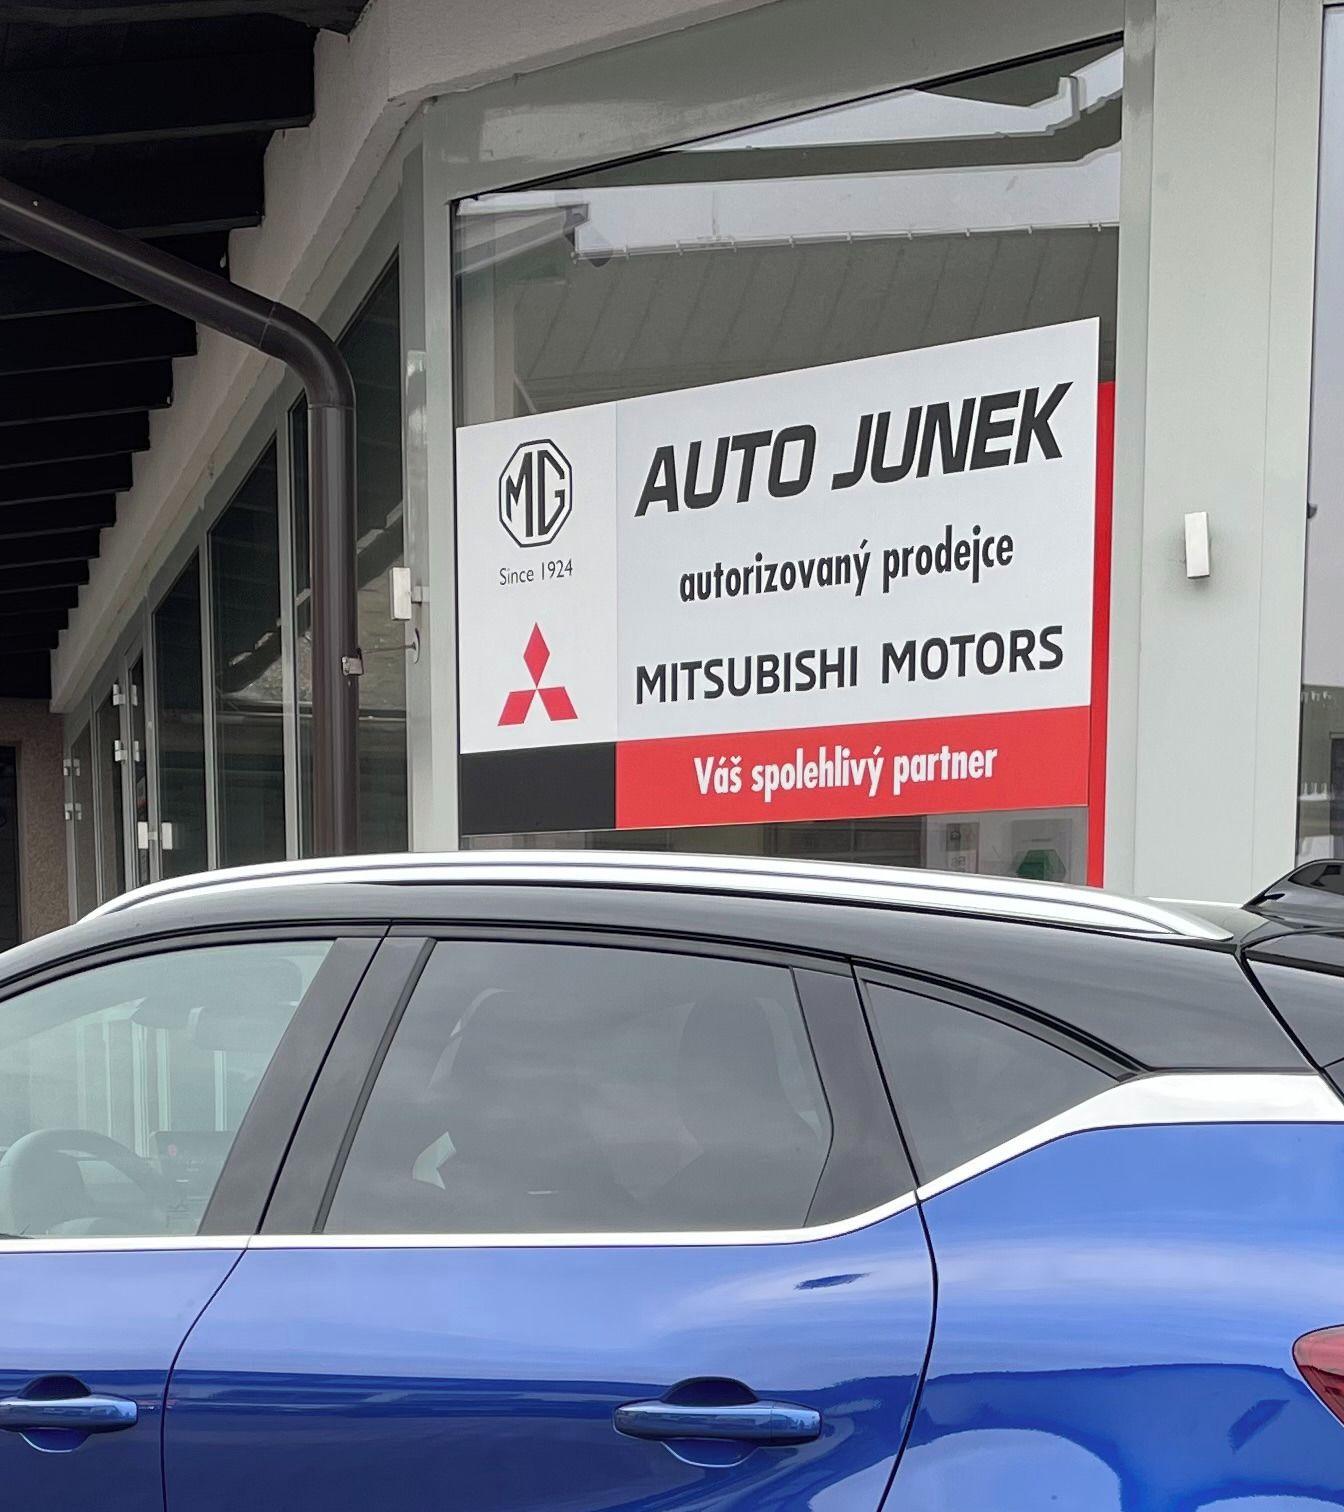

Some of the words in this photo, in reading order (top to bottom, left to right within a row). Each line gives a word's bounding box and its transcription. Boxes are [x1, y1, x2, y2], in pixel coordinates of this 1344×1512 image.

[634, 424, 816, 517] AUTO
[831, 381, 1074, 490] JUNEK
[504, 446, 568, 541] MG
[499, 564, 535, 585] Since
[540, 557, 574, 582] 1924
[679, 539, 873, 603] autorizovaný
[882, 523, 1014, 595] prodejce
[636, 645, 859, 705] MITSUBISHI
[881, 625, 1064, 684] MOTORS
[693, 753, 743, 796] Váš
[751, 743, 883, 802] spolehlivý
[892, 743, 998, 785] partner
